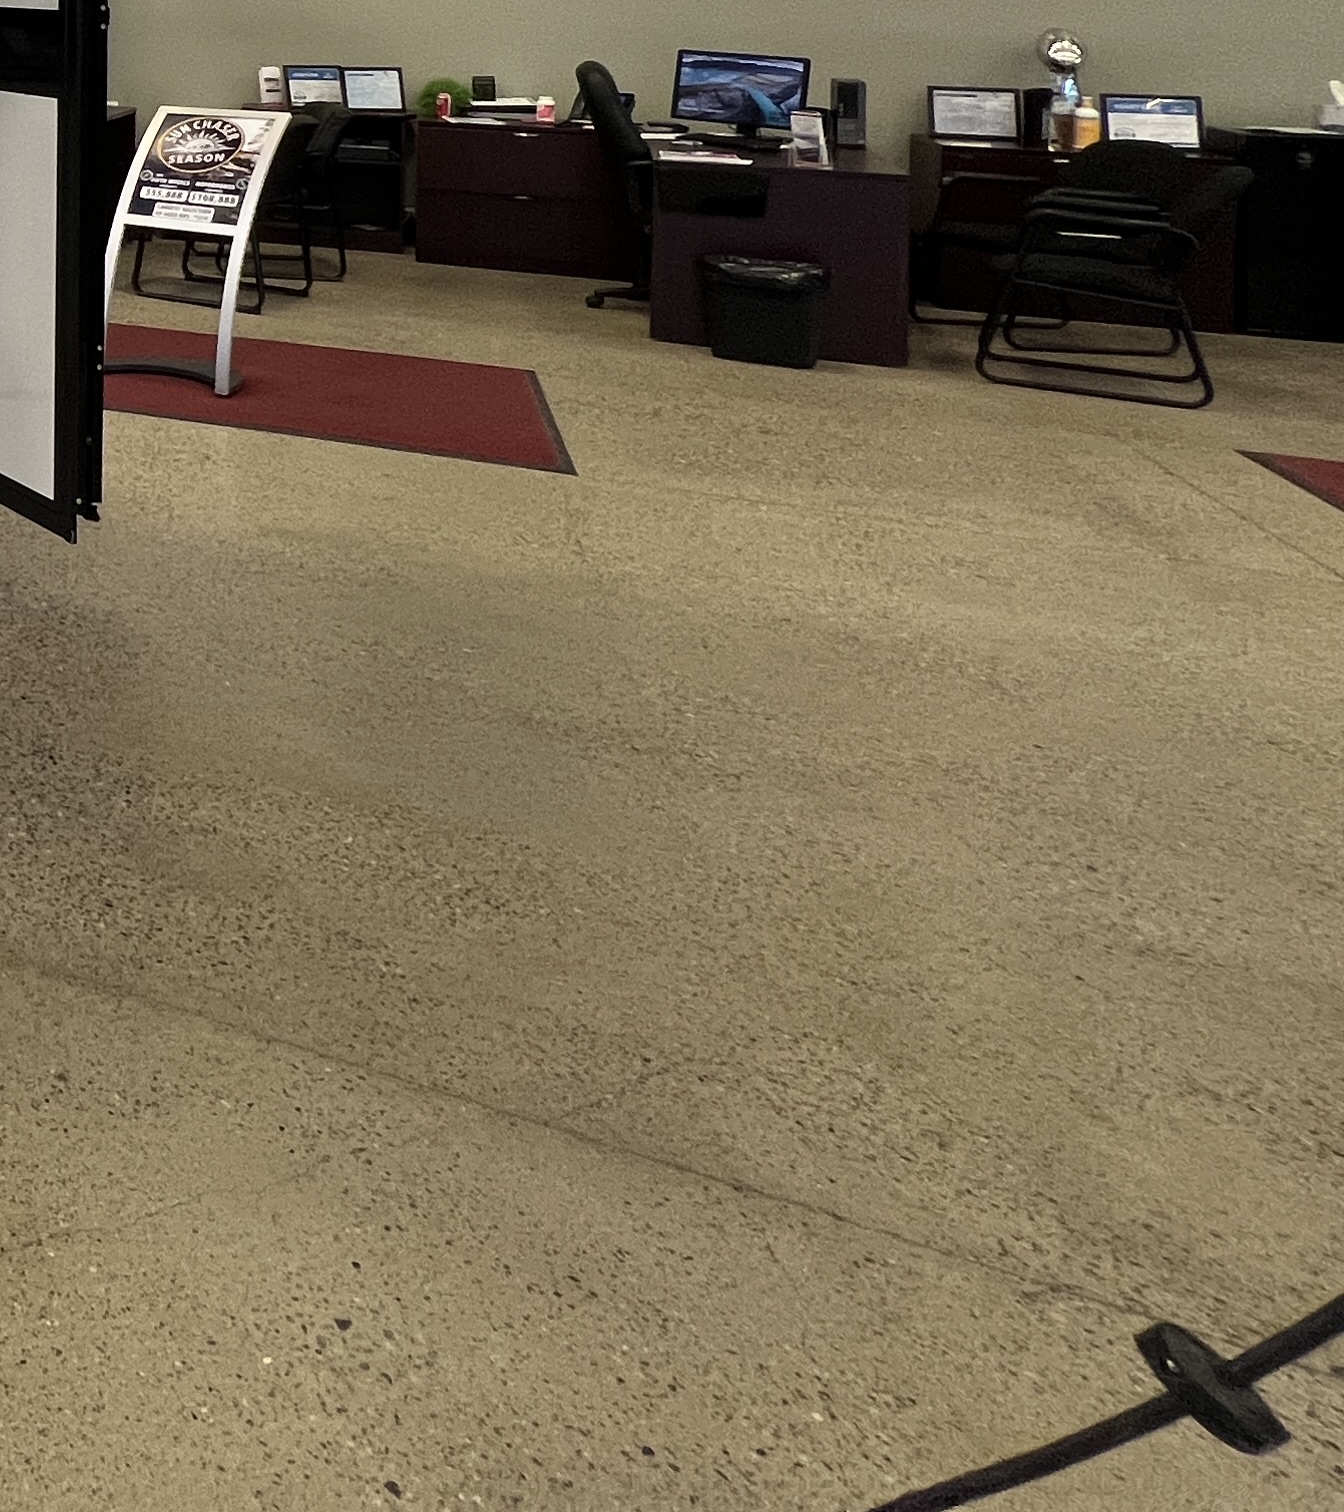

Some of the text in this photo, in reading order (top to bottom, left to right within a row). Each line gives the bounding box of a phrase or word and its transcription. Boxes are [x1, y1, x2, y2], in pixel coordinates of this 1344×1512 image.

[164, 119, 240, 144] SUN CHASER
[168, 153, 226, 164] SEASON
